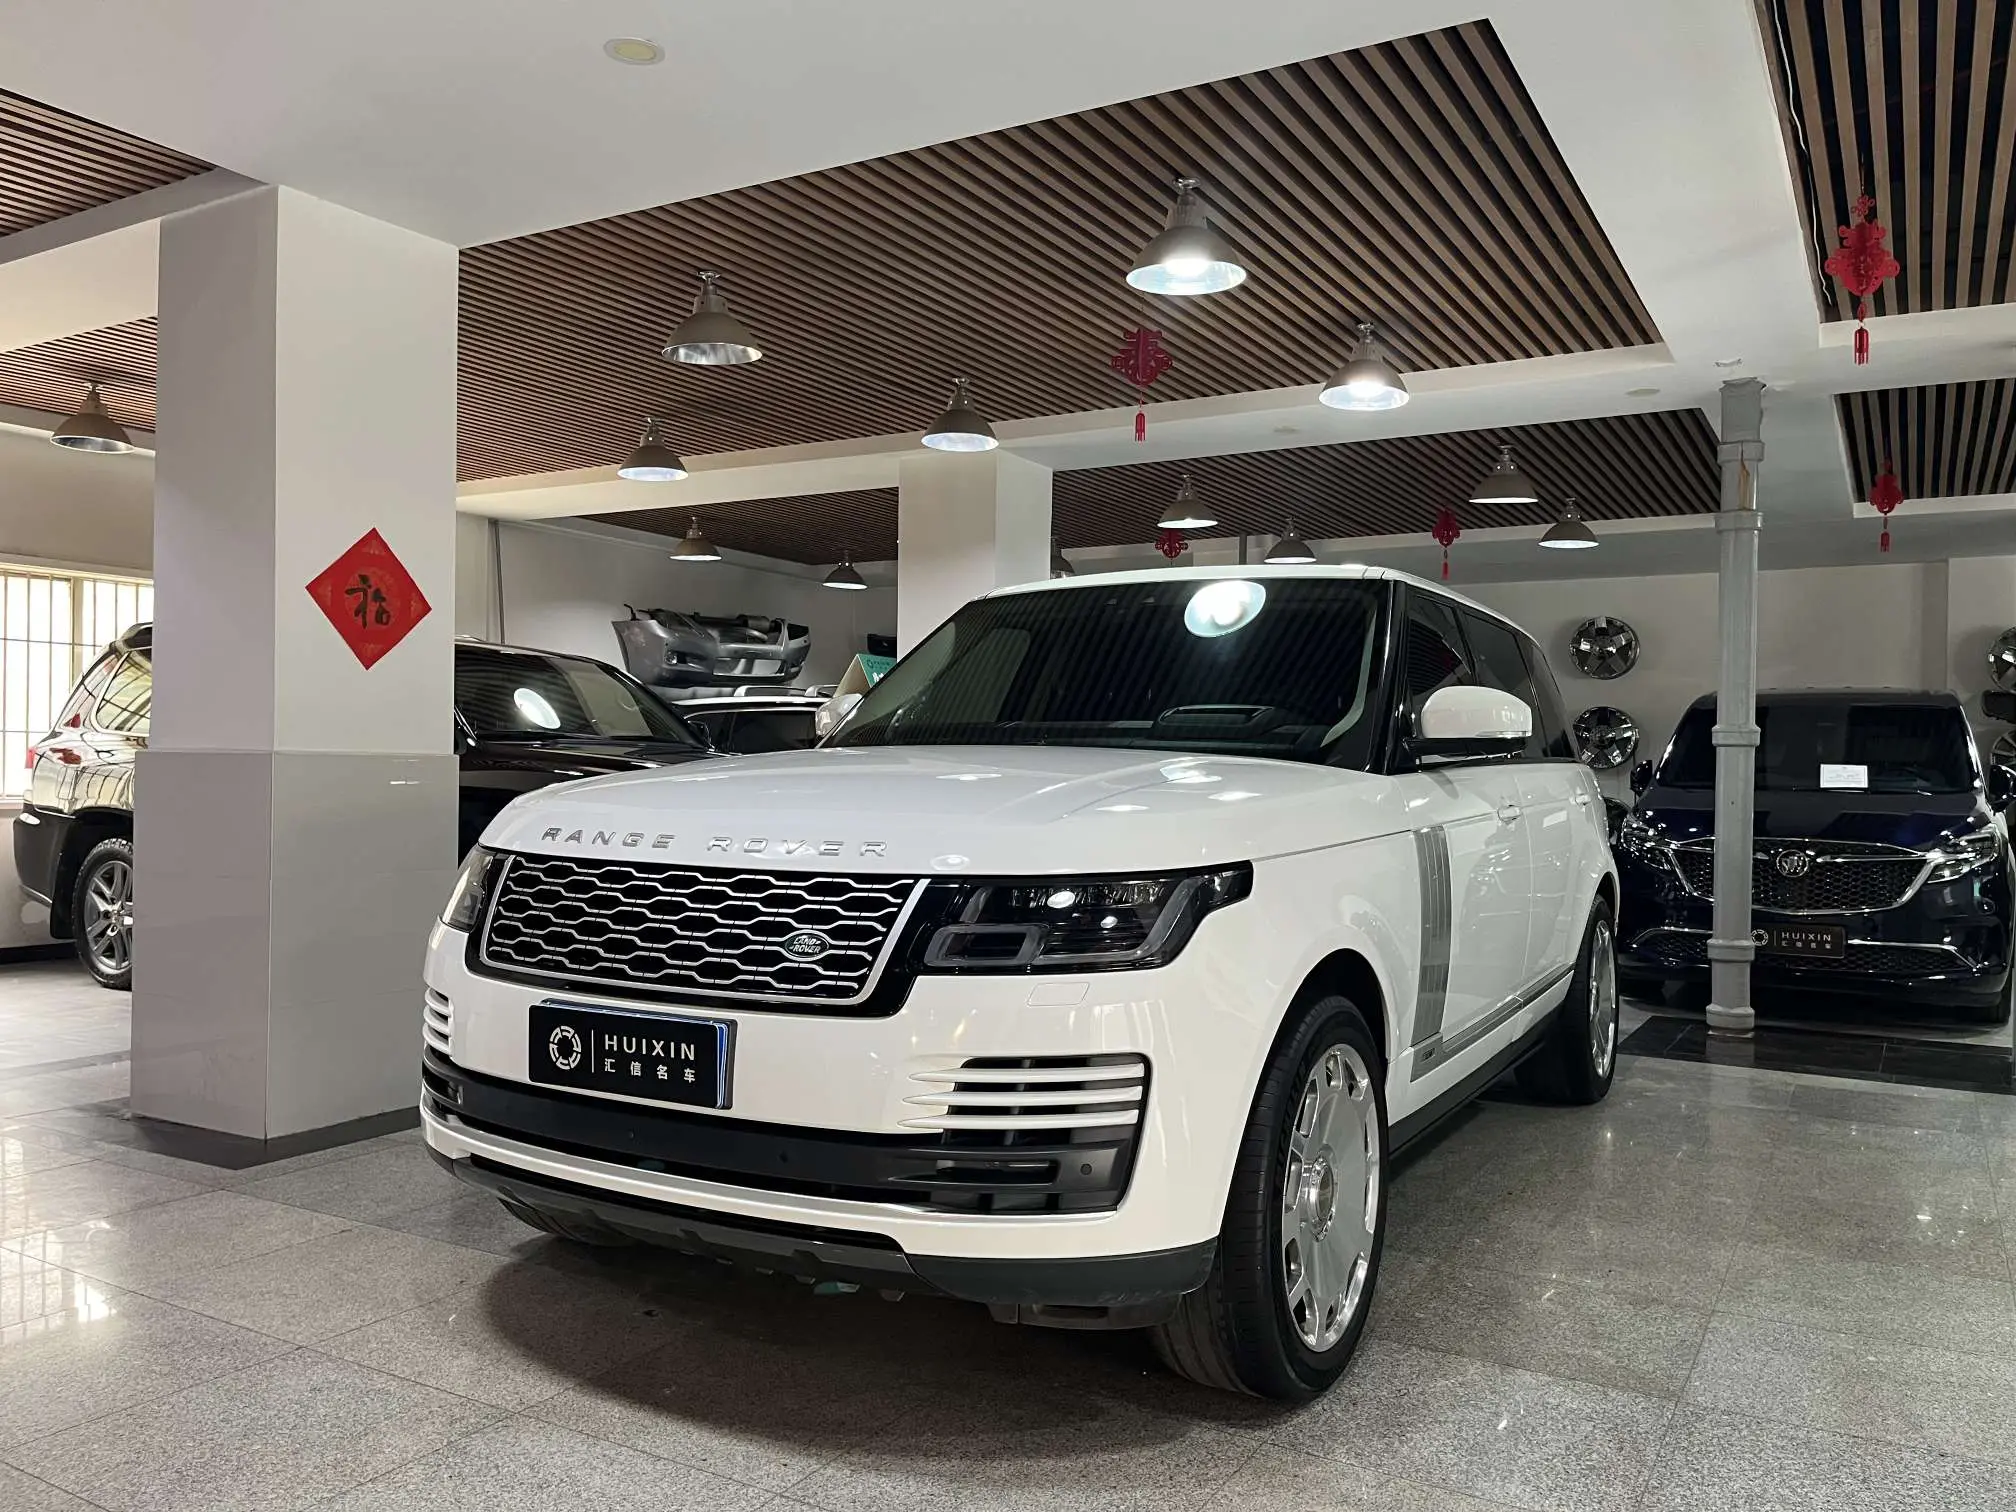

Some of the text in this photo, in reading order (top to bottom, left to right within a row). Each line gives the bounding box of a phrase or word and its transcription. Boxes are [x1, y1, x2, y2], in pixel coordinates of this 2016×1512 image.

[345, 574, 391, 629] 福
[541, 827, 887, 857] RANGE ROVER
[1781, 931, 1831, 941] HUIXIN
[793, 944, 821, 954] ROVER
[604, 1034, 695, 1060] HUIXIN
[604, 1058, 696, 1083] 汇信名车
